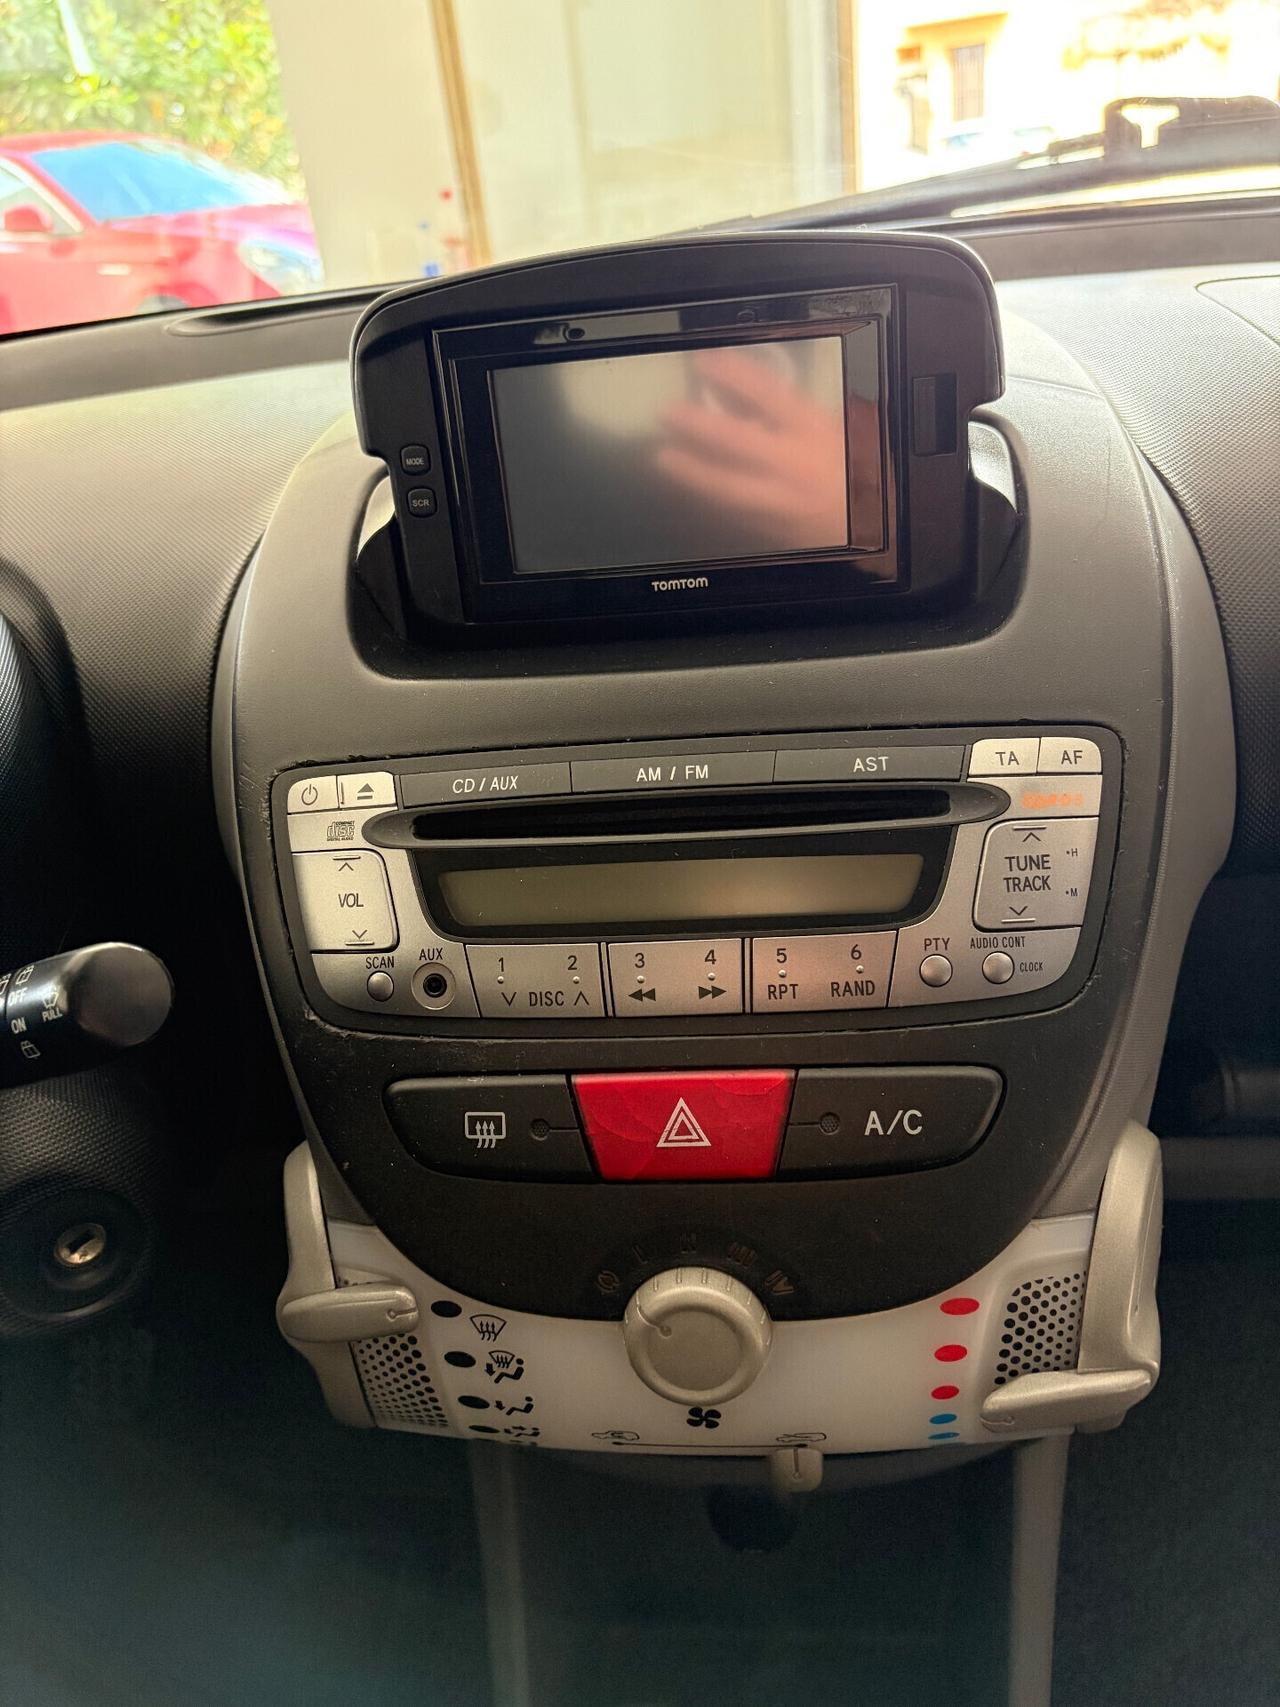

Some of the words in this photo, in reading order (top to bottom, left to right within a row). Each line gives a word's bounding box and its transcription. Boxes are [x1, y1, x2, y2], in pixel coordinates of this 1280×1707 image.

[405, 457, 424, 466] MODE
[412, 499, 430, 507] SCR
[853, 757, 889, 772] AST
[995, 751, 1020, 766] TA
[1061, 750, 1083, 765] AF
[635, 765, 662, 782] AM
[685, 764, 709, 780] FM
[452, 778, 476, 794] CD
[489, 775, 519, 791] AUX
[1004, 854, 1051, 873] TUNE
[1003, 875, 1051, 893] TRACK
[338, 893, 364, 908] VOL
[923, 937, 950, 951] PTY
[969, 937, 998, 949] AUDIO
[1002, 936, 1026, 948] CONT
[418, 947, 444, 961] AUX
[704, 949, 717, 965] 4
[776, 947, 787, 964] 5
[851, 944, 862, 960] 6
[365, 956, 395, 970] SCAN
[497, 957, 505, 972] 1
[568, 956, 577, 971] 2
[634, 952, 645, 969] 3
[1019, 961, 1043, 973] CLOCK
[8, 988, 27, 1006] OFF
[768, 984, 798, 999] RPT
[830, 982, 875, 997] RAND
[529, 991, 564, 1007] DISC
[42, 1009, 63, 1022] PULL
[11, 1017, 26, 1034] ON
[864, 1109, 923, 1136] A/C
